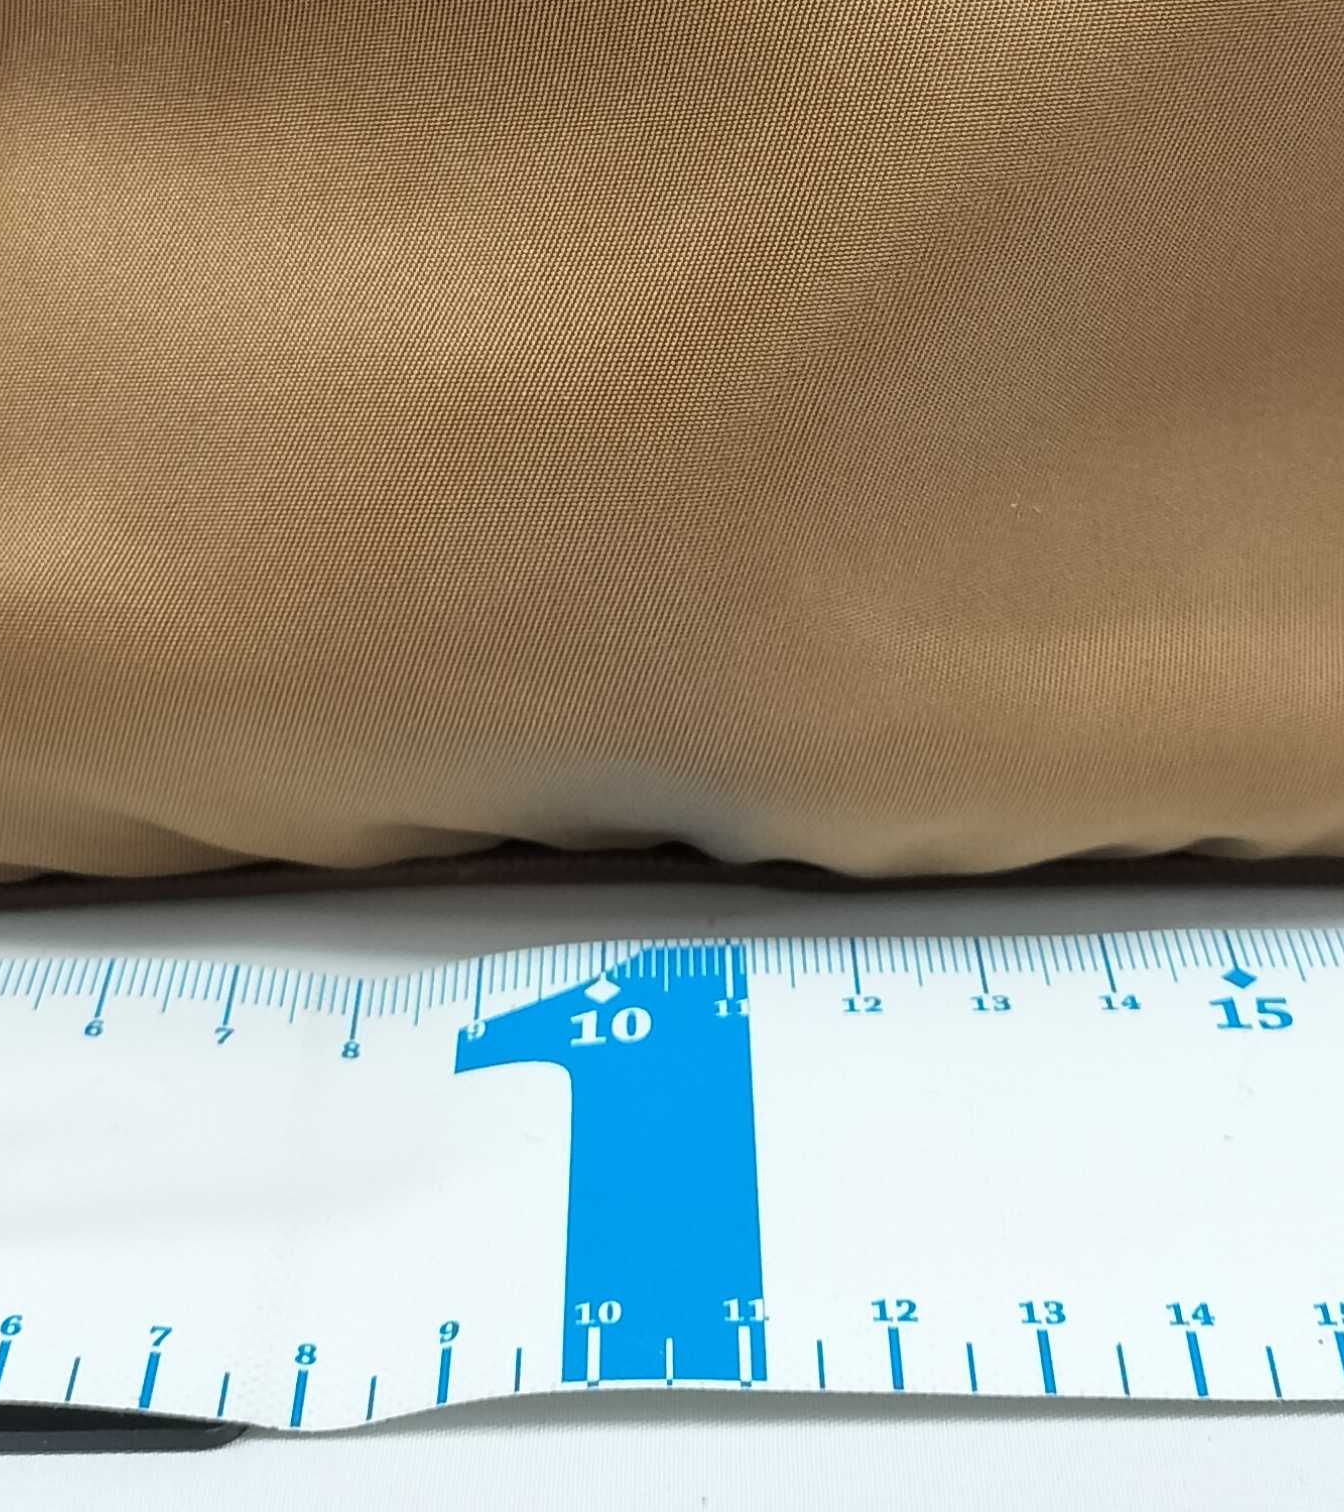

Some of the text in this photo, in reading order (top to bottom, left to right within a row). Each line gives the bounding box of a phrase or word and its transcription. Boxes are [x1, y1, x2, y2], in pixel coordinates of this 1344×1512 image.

[83, 1021, 105, 1037] 6
[214, 1028, 235, 1045] 7
[341, 1041, 360, 1059] 8
[465, 1022, 486, 1040] 9
[570, 1007, 652, 1046] 10
[713, 1000, 750, 1017] 11
[842, 996, 884, 1014] 12
[970, 995, 1012, 1012] 13
[1100, 995, 1141, 1010] 14
[1209, 997, 1294, 1030] 15
[454, 944, 767, 1383] 1
[0, 1315, 23, 1336] 6
[149, 1327, 173, 1347] 7
[294, 1344, 317, 1365] 8
[439, 1321, 460, 1343] 9
[573, 1302, 623, 1325] 10
[722, 1299, 770, 1322] 11
[871, 1300, 919, 1323] 12
[1018, 1302, 1066, 1324] 13
[1166, 1303, 1216, 1327] 14
